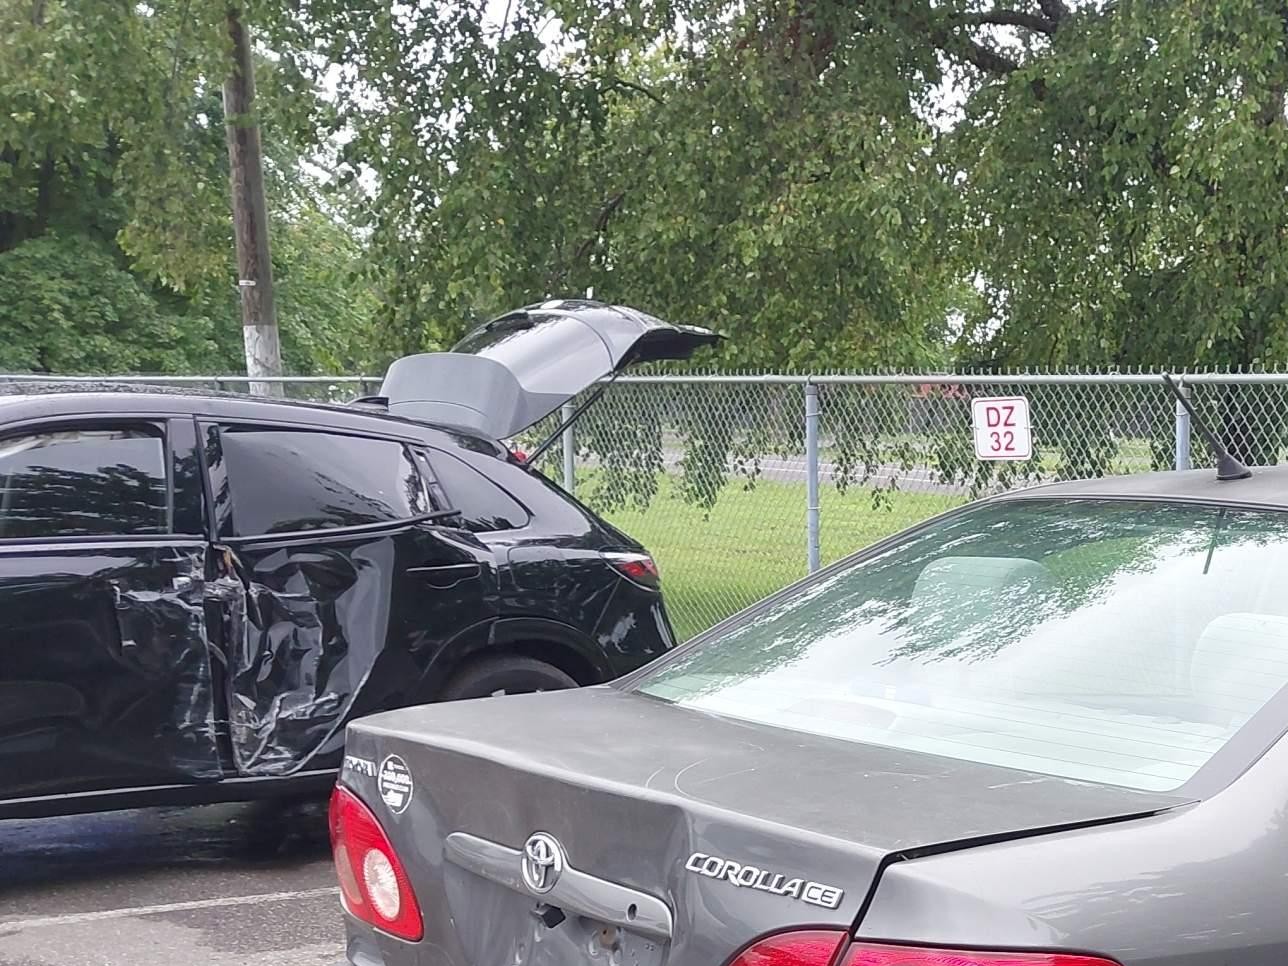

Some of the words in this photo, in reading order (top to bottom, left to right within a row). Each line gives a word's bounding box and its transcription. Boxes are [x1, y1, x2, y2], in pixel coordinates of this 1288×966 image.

[986, 406, 1016, 427] DZ
[990, 431, 1015, 451] 32
[685, 853, 804, 899] COROLLA
[803, 882, 843, 908] CE
